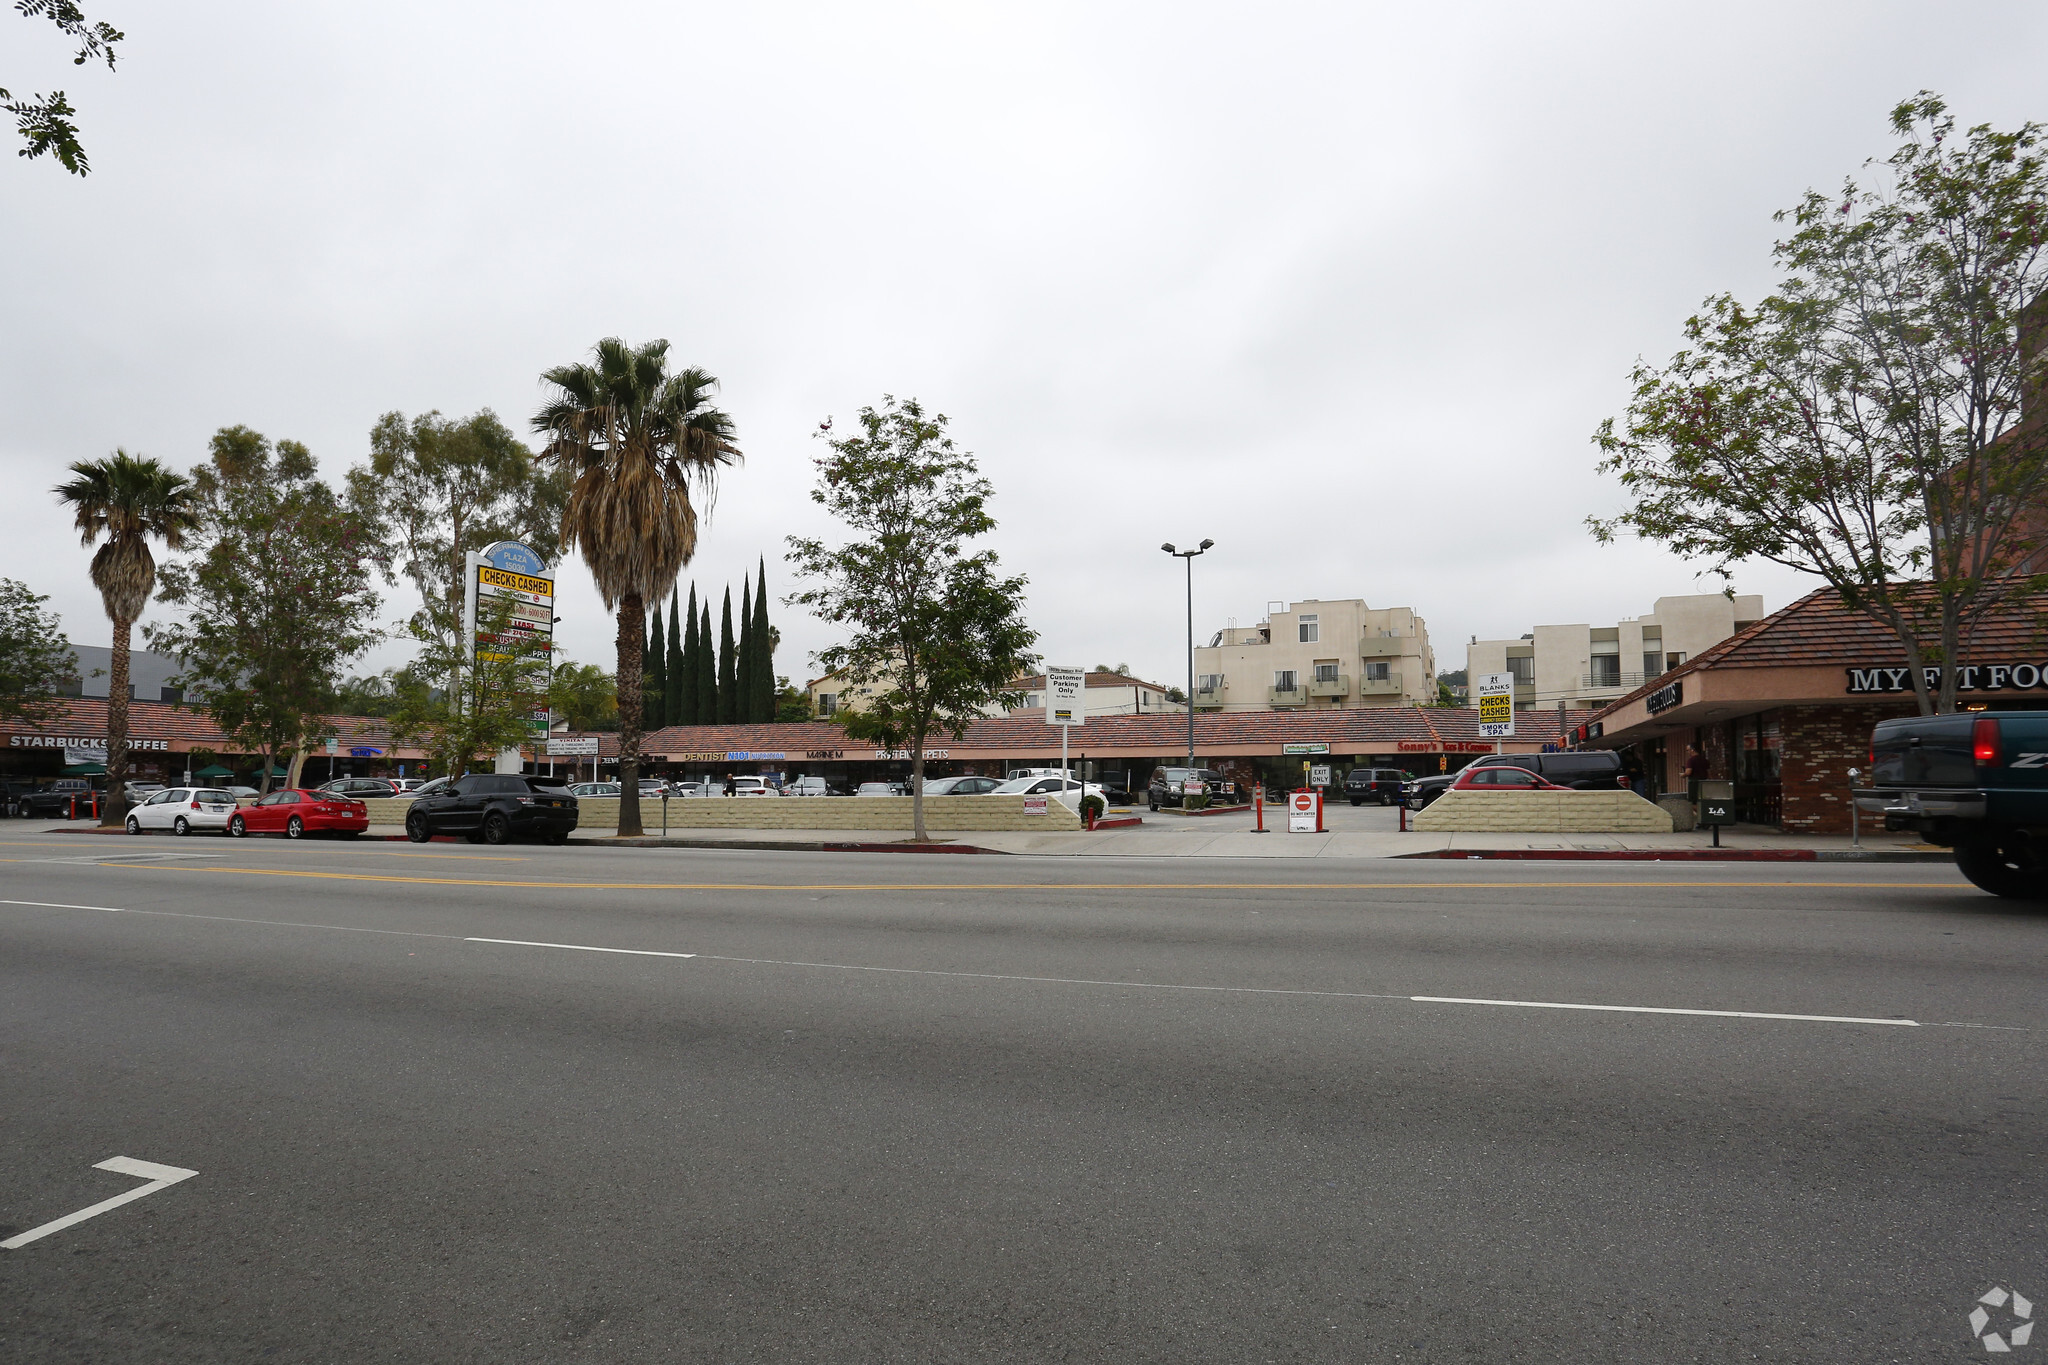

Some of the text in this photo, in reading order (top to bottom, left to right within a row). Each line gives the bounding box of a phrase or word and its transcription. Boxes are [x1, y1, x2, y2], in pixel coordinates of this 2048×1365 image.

[488, 544, 542, 568] SHERMAN OAKS
[504, 552, 527, 564] PLAZA
[484, 570, 548, 594] CHECKS CASHED
[514, 620, 535, 629] LEASE
[1851, 664, 2048, 691] MY FT FO
[1054, 680, 1078, 688] Parking
[1480, 684, 1510, 692] BLANKS
[1480, 696, 1510, 706] CHECKS
[1480, 706, 1510, 716] CASHED
[10, 736, 168, 750] STARBUCKS OFFEE
[1398, 742, 1437, 752] Sonny's
[685, 752, 726, 760] DENTIST
[728, 752, 750, 760] N101
[927, 750, 949, 758] PETS
[2010, 753, 2048, 768] Z
